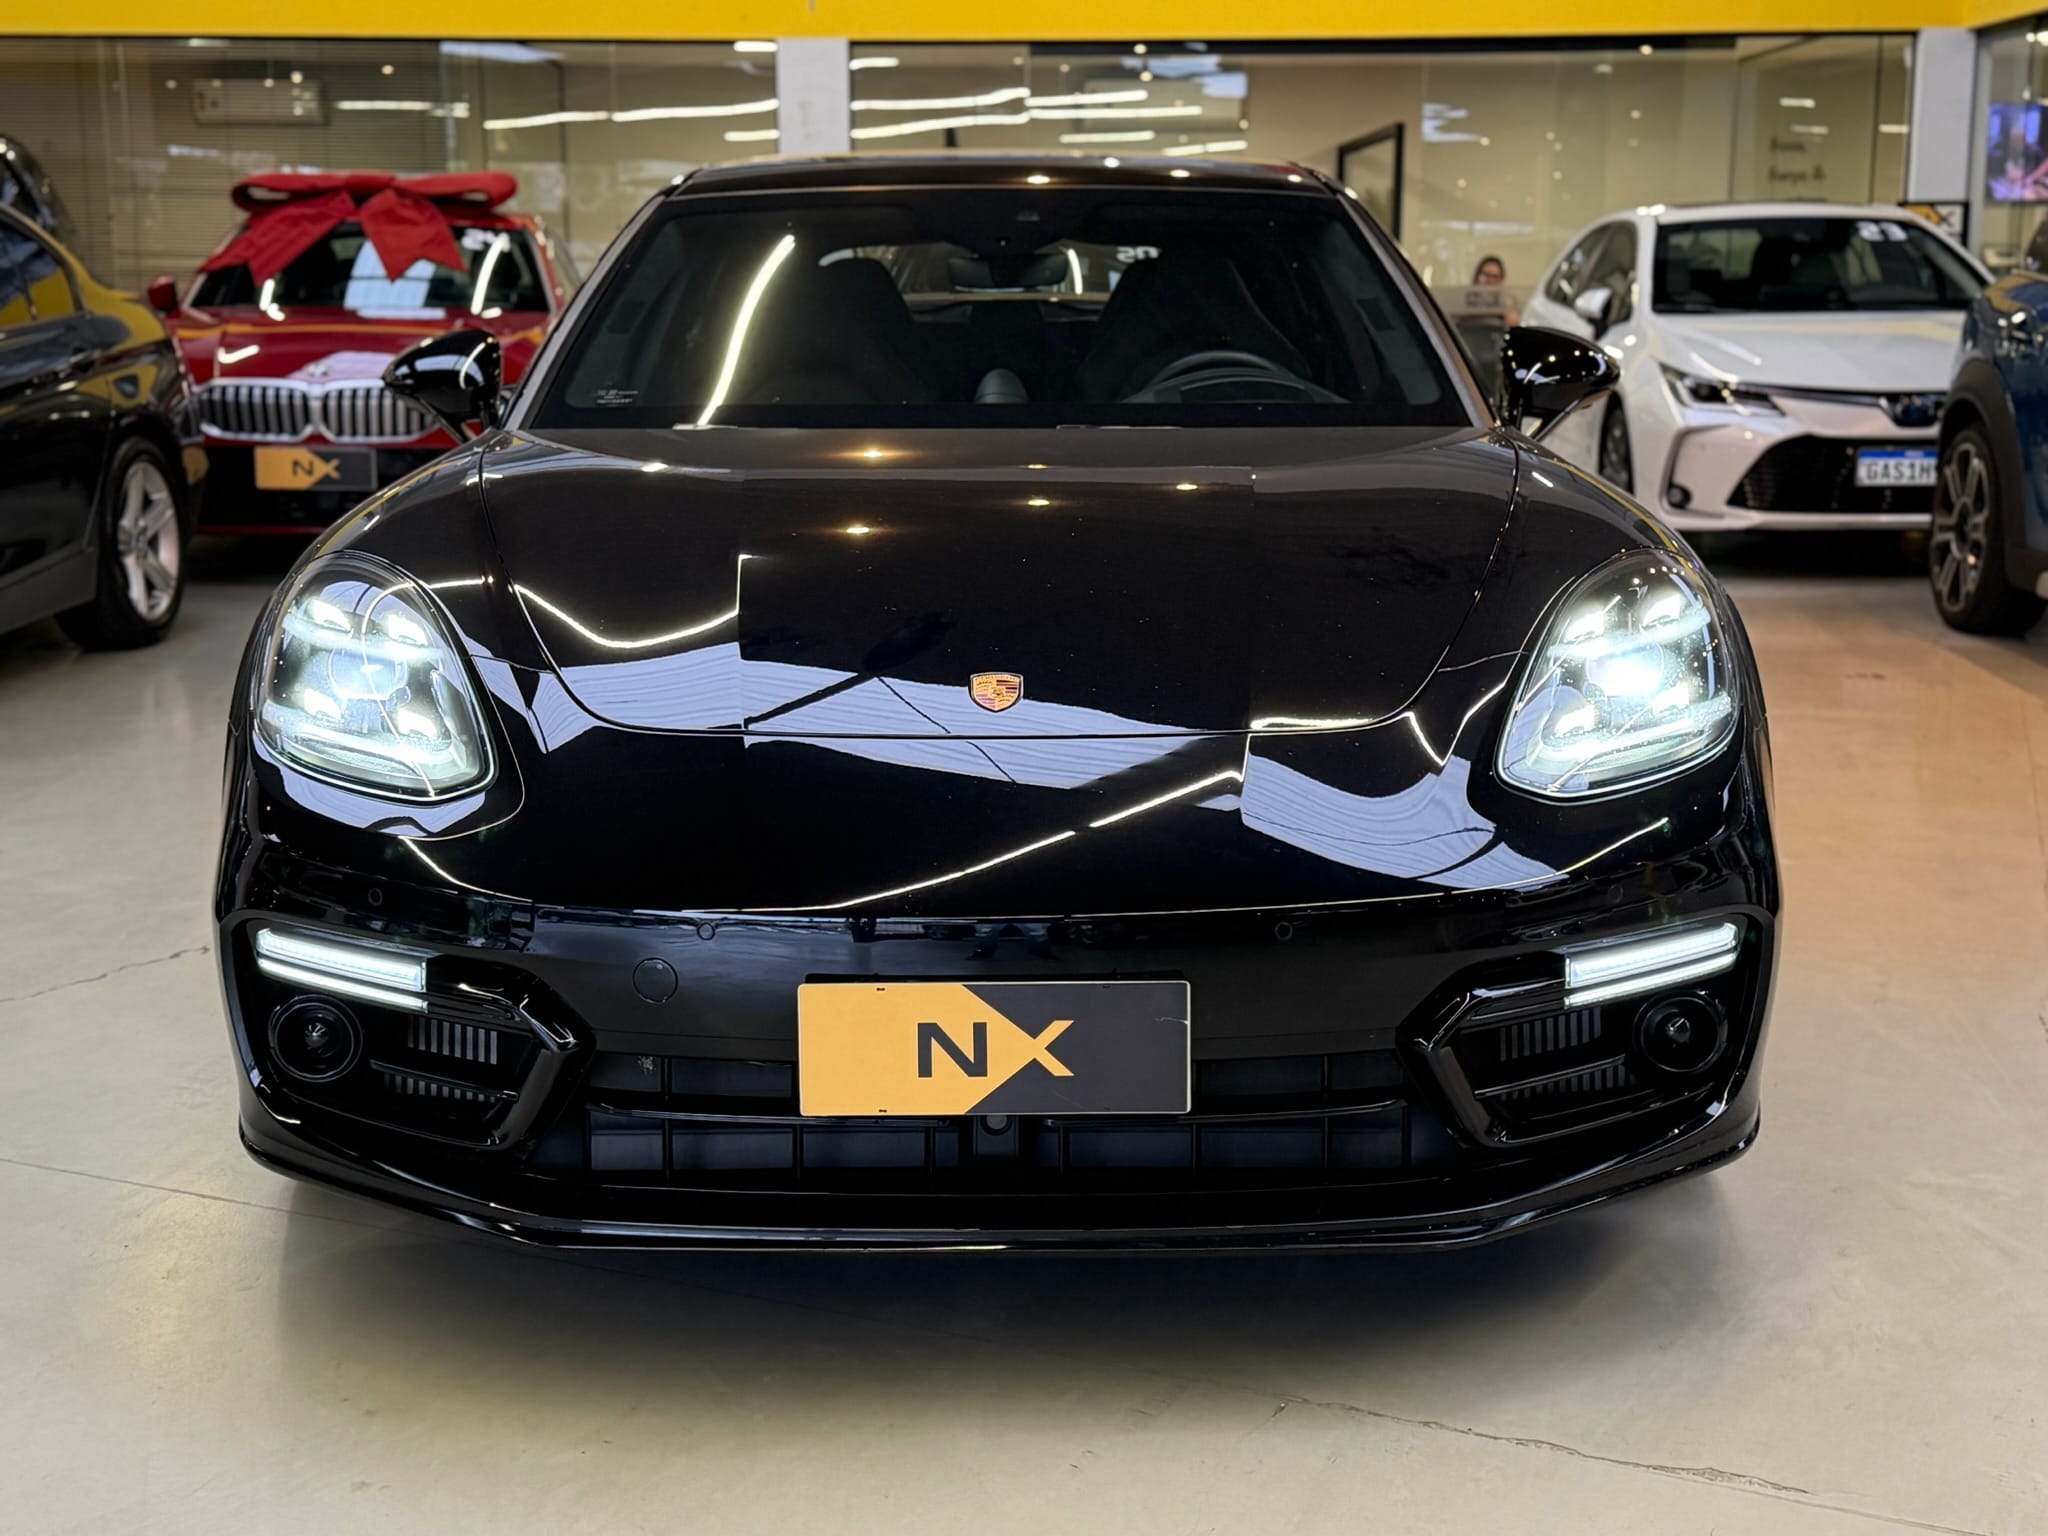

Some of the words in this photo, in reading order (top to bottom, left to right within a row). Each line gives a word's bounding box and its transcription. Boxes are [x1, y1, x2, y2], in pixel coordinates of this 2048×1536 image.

[1857, 221, 1907, 241] 23
[292, 459, 341, 479] NX
[1866, 461, 1935, 480] GAS1H
[917, 1020, 1075, 1078] NX
